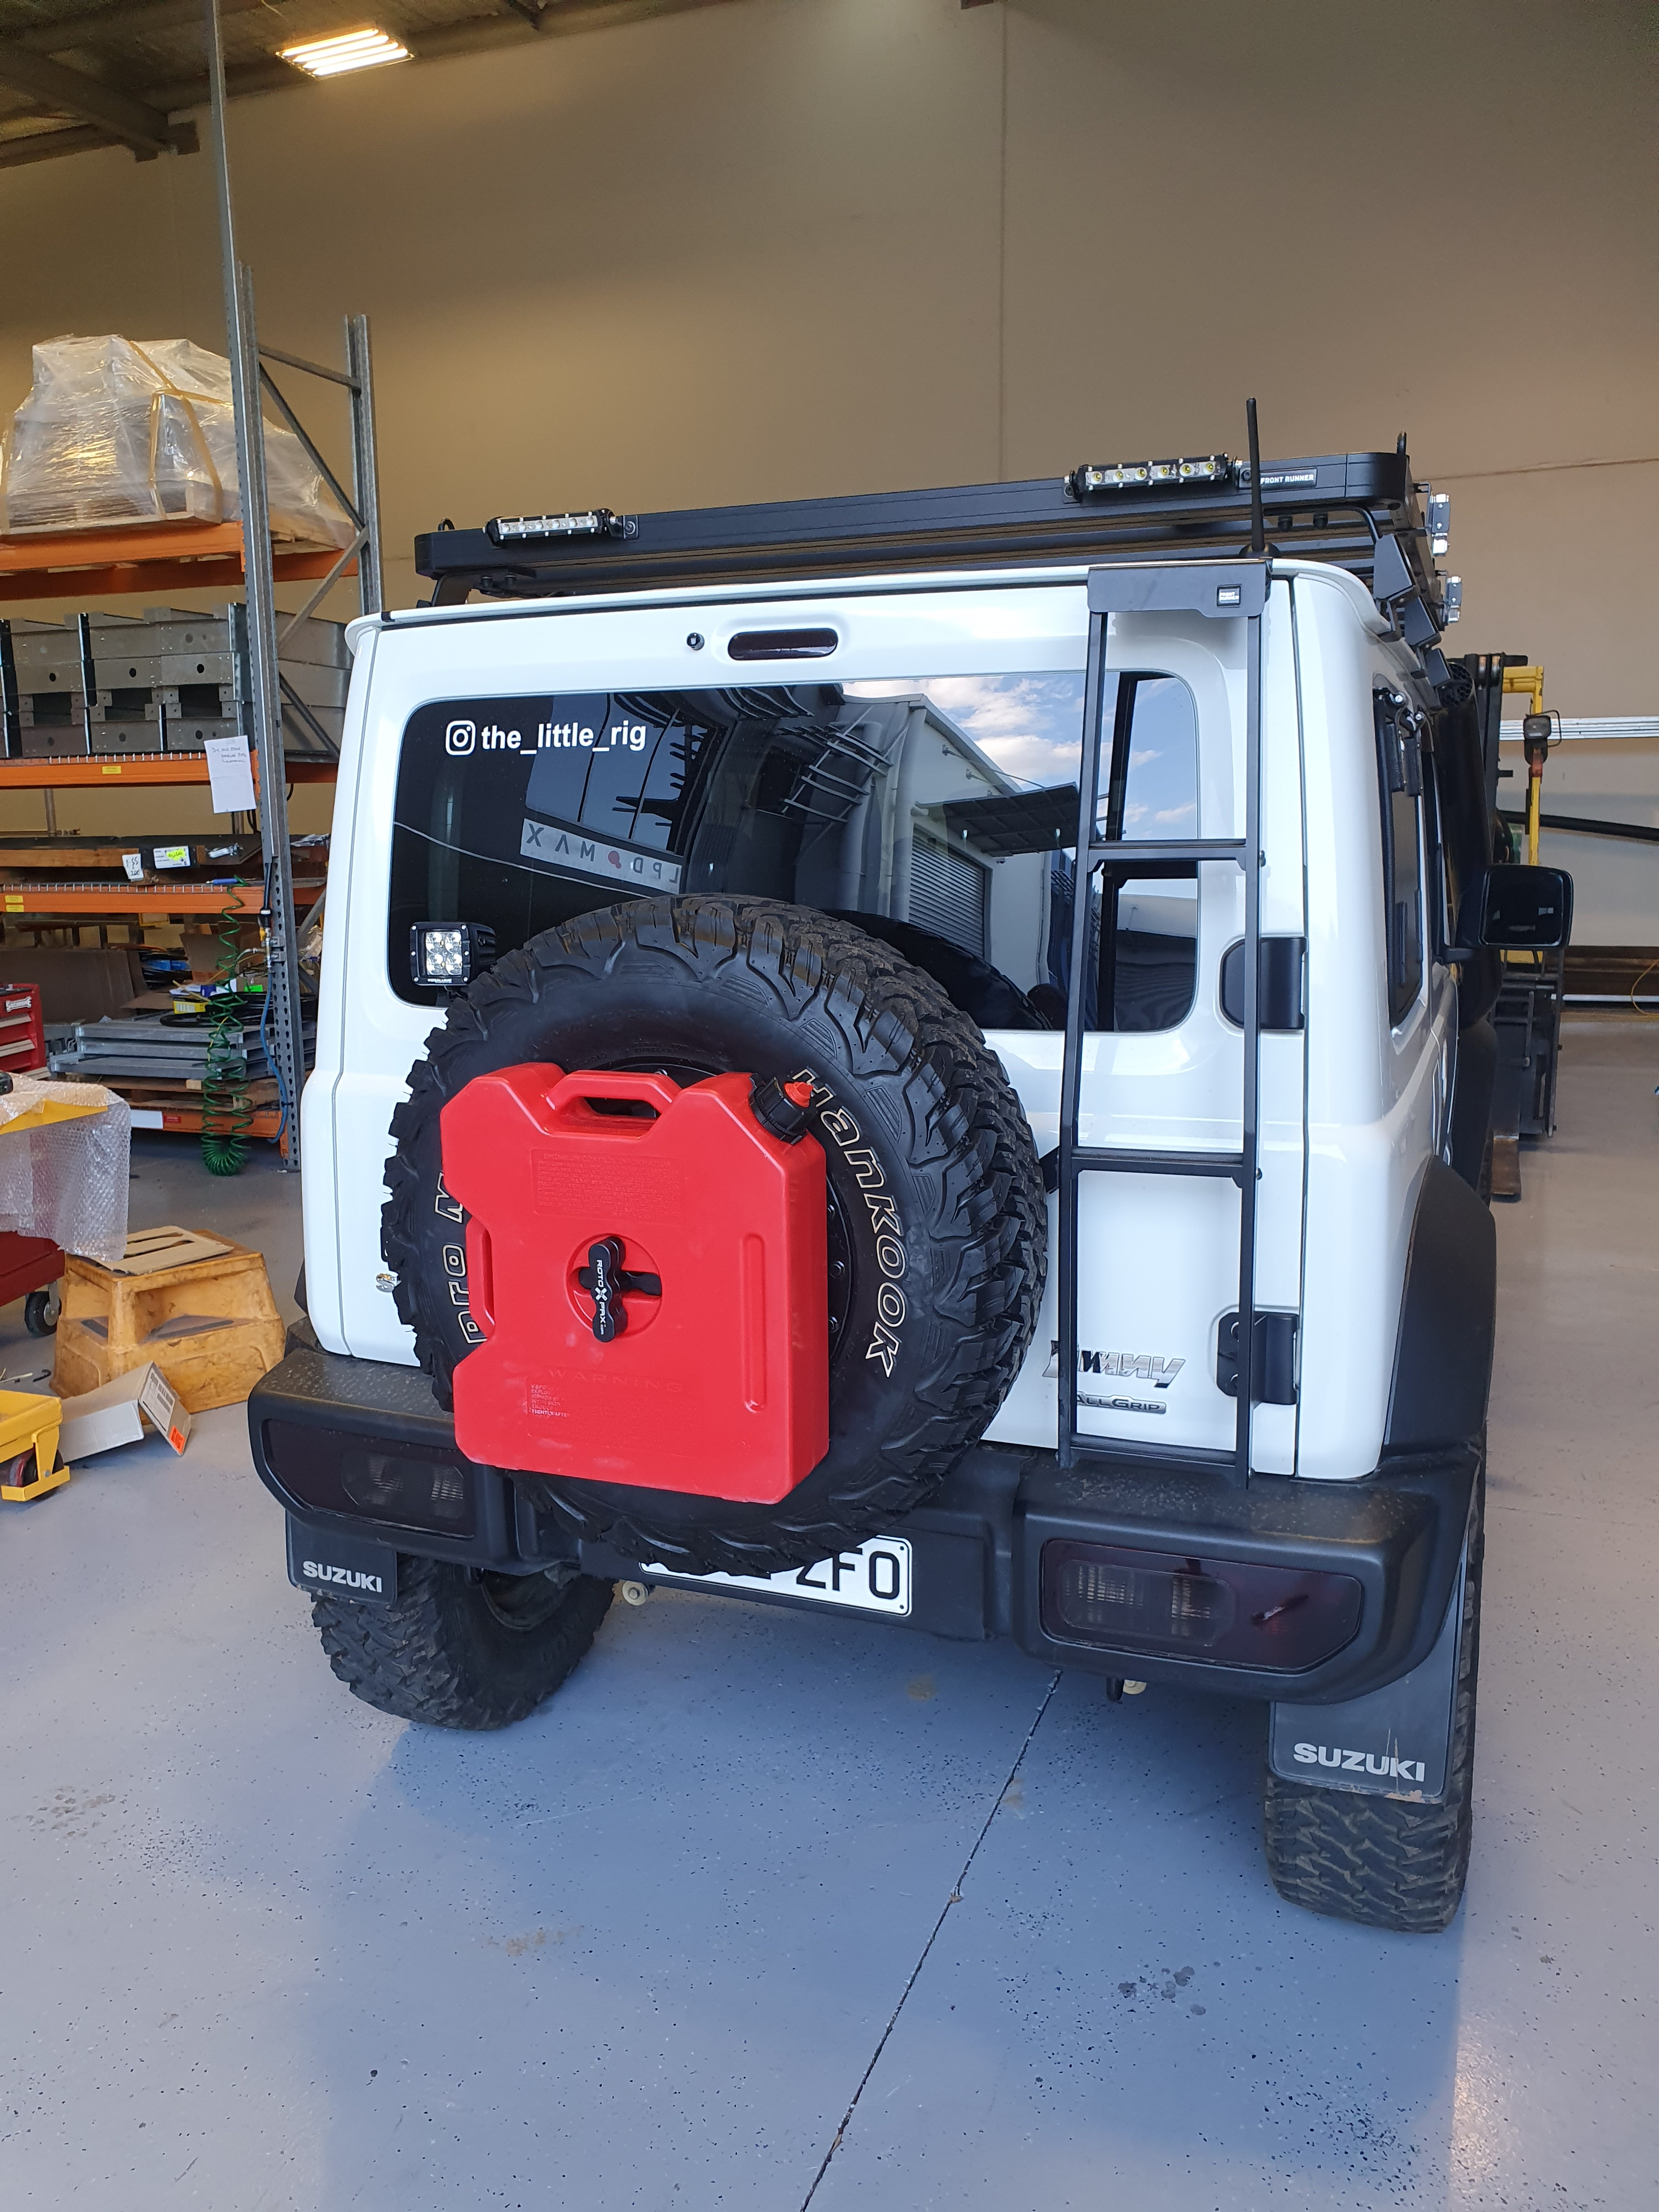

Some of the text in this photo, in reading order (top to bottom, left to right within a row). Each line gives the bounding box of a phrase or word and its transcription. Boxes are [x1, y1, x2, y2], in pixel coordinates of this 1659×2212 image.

[1285, 474, 1314, 482] RUNNER
[481, 720, 646, 754] the_little_rig
[549, 1368, 682, 1392] WARNING
[303, 1561, 382, 1593] SUZUKI
[1293, 1743, 1425, 1782] SUZUKI
